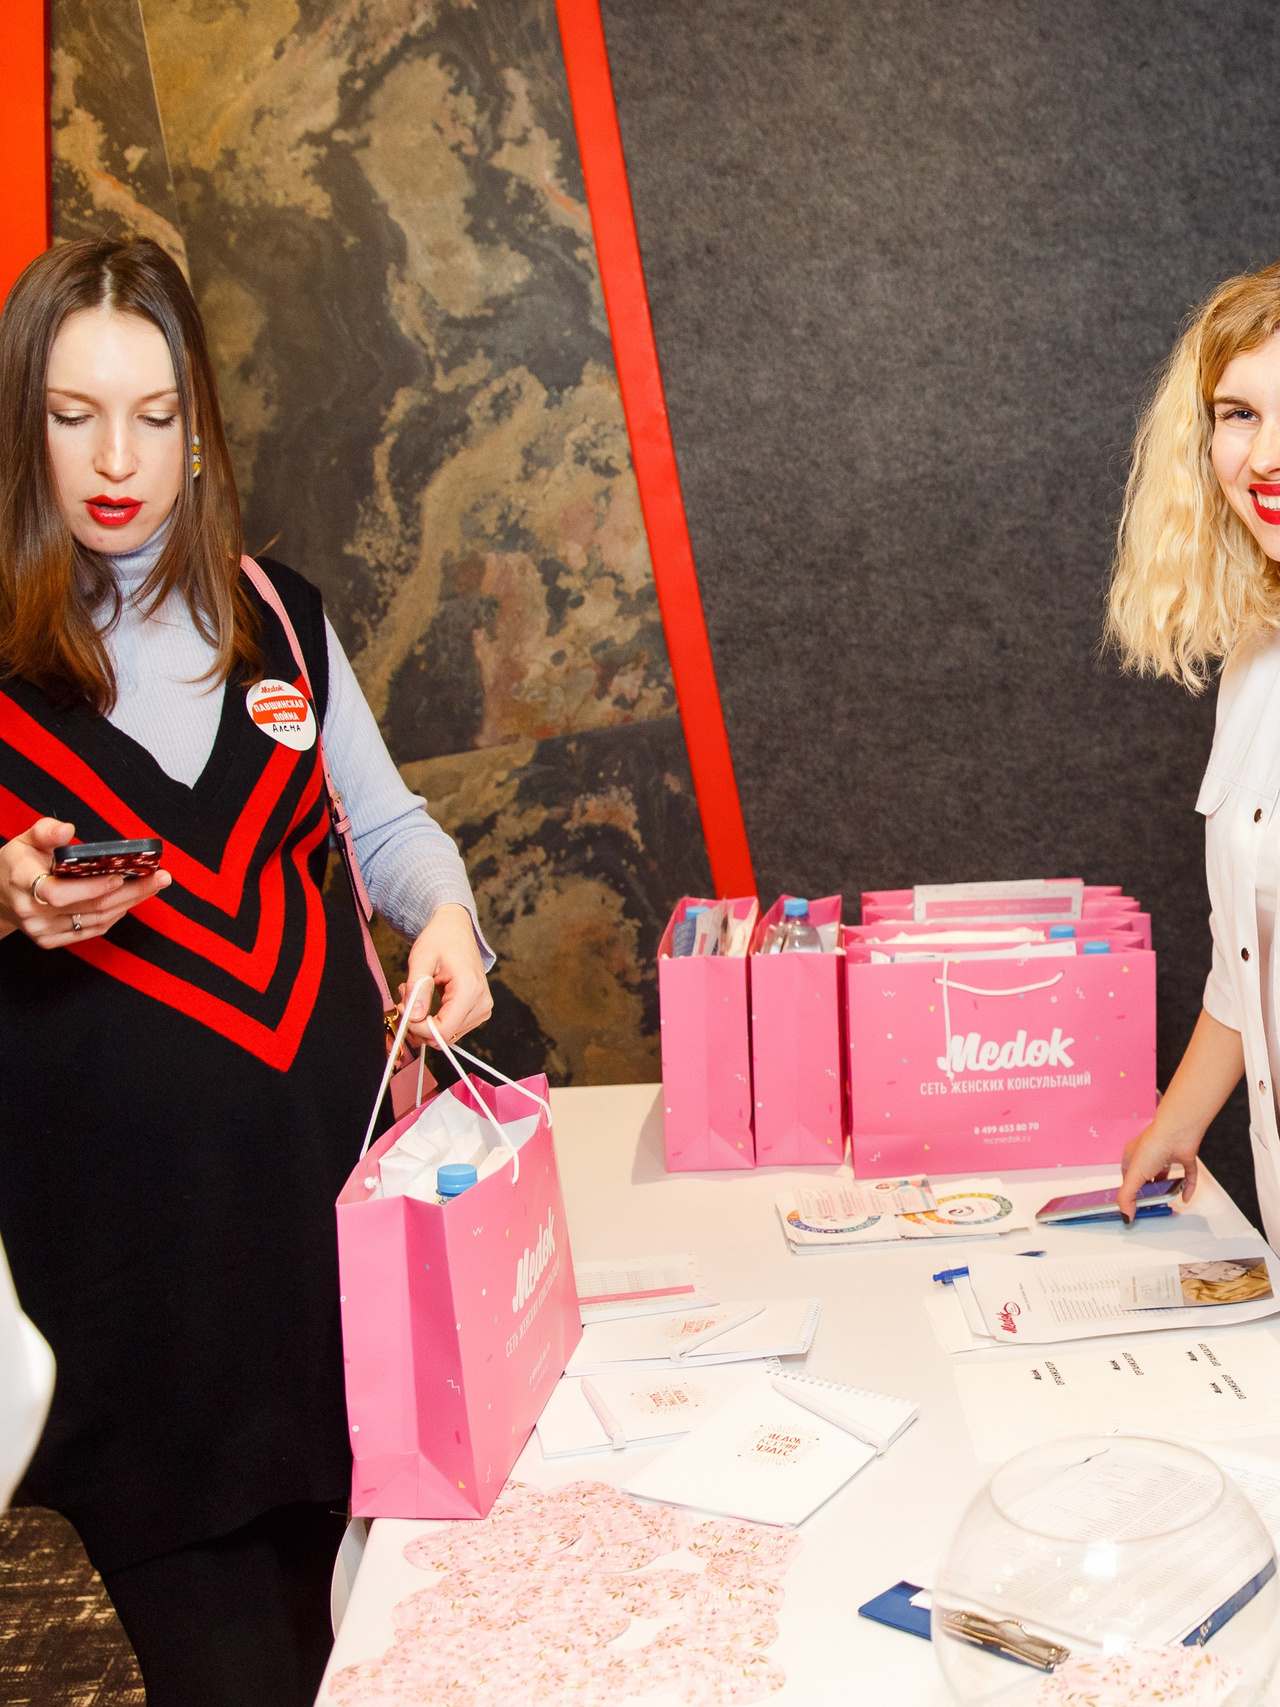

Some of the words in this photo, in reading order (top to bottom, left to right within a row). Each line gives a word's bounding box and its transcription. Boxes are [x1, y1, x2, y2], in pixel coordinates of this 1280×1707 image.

[253, 699, 305, 713] ПАВШИНСКАЯ
[273, 711, 300, 721] ПОЙМА
[937, 1028, 1075, 1073] Medok
[920, 1081, 948, 1096] СЕТЬ
[951, 1077, 1004, 1094] ЖЕНСКИХ
[1007, 1070, 1091, 1090] КОНСУЛЬТАЦИЙ
[974, 1126, 980, 1135] 8
[982, 1124, 997, 1134] 499
[999, 1123, 1014, 1134] 653
[1016, 1123, 1027, 1132] 80
[1029, 1122, 1039, 1131] 70
[512, 1206, 556, 1314] Medok
